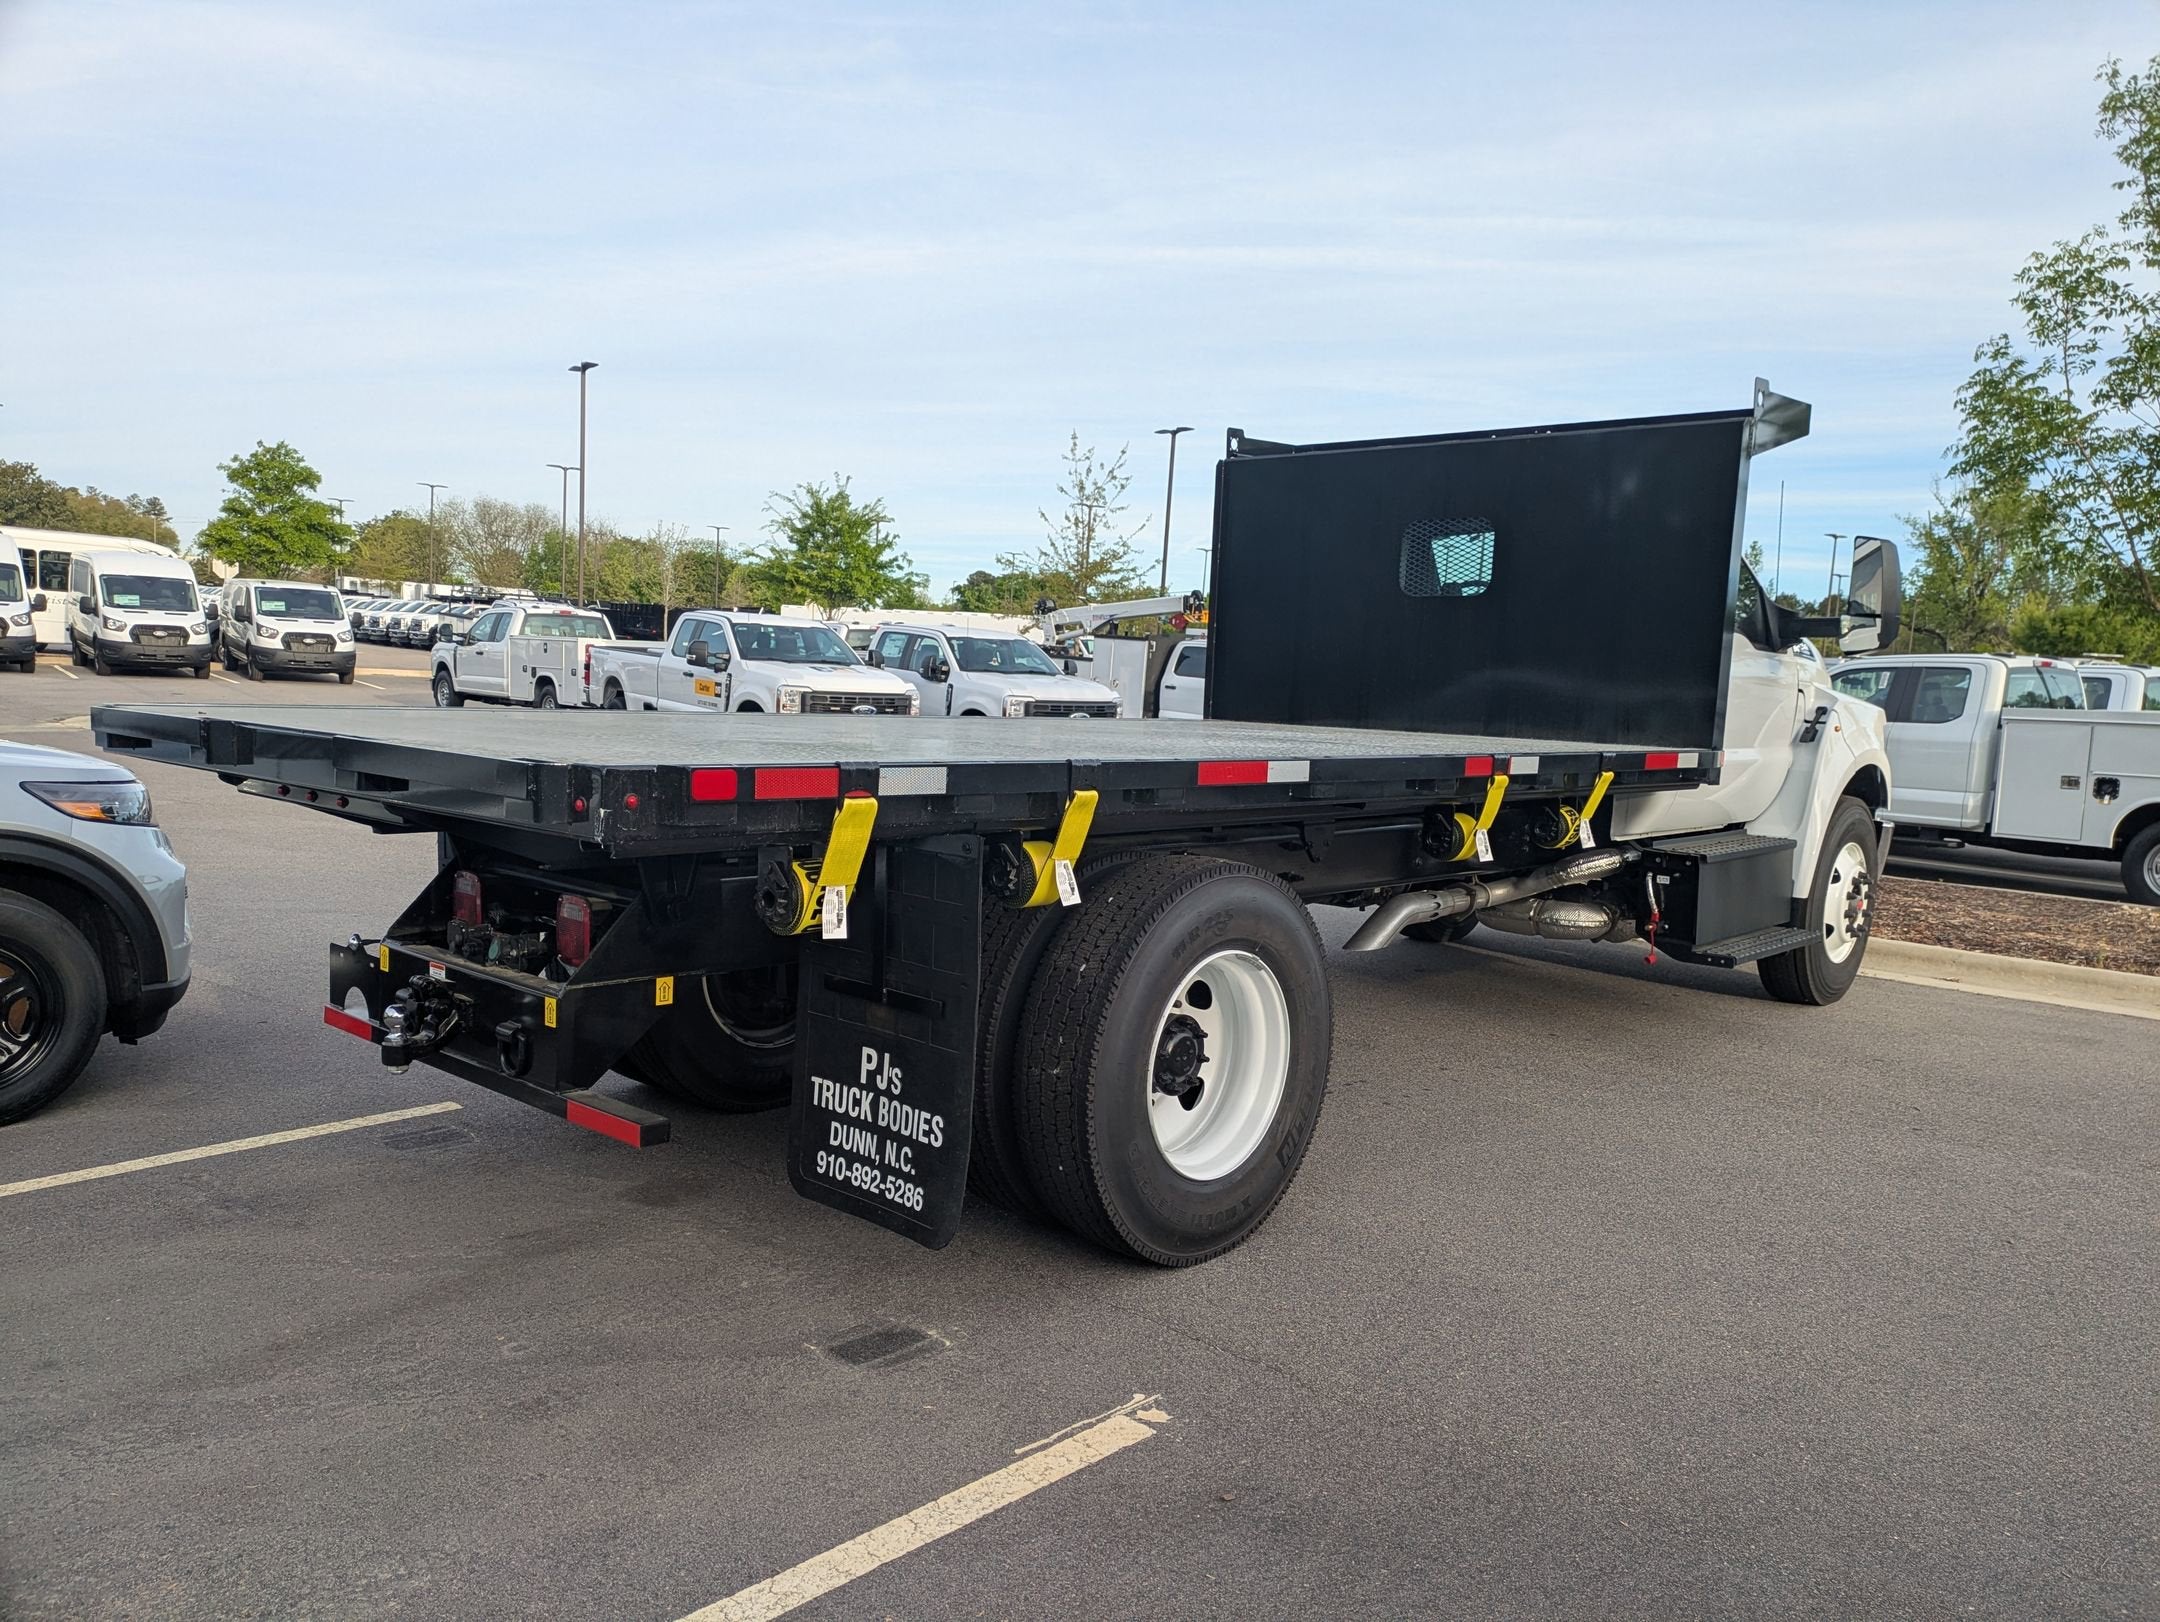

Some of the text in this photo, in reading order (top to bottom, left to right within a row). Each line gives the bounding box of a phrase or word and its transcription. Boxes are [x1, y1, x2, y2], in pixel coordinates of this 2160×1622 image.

[860, 1046, 902, 1095] PJ's
[811, 1076, 944, 1148] TRUCK BODIES
[829, 1121, 916, 1175] DUNN, N.C.
[816, 1150, 924, 1212] 910-892-5286
